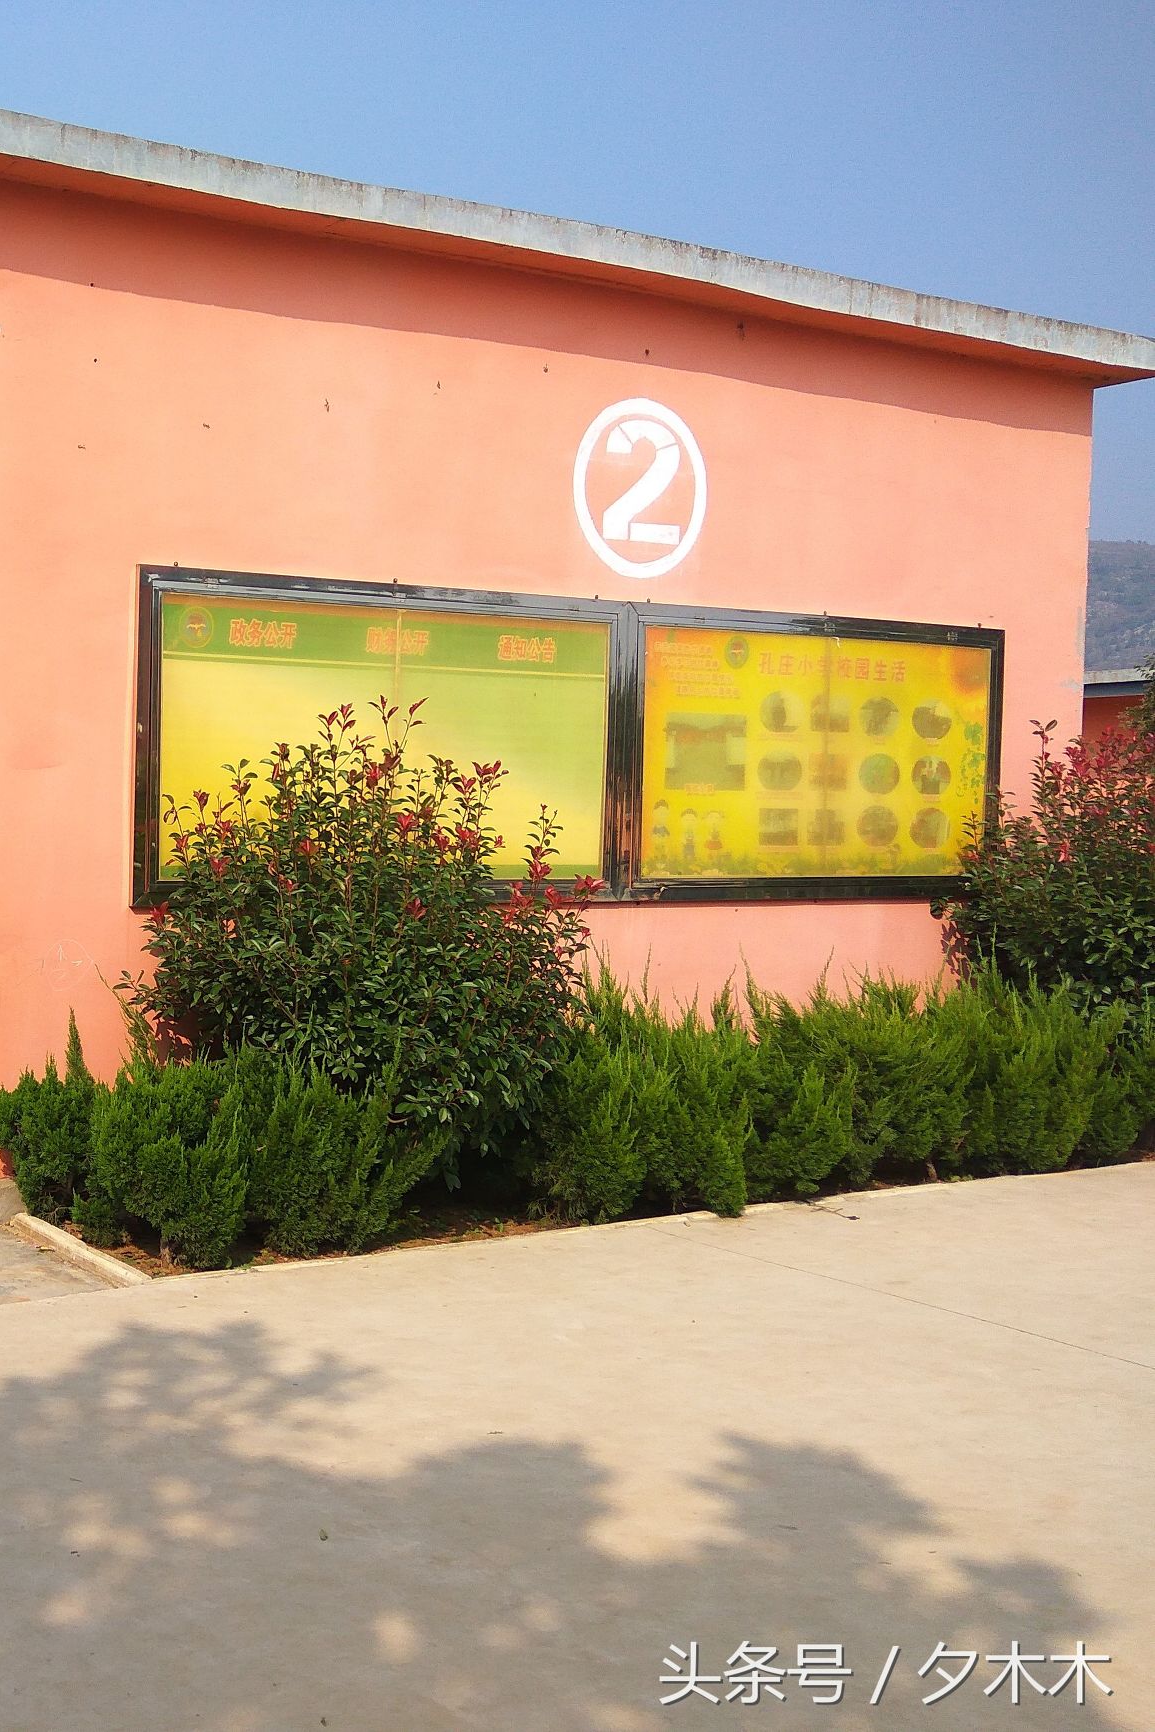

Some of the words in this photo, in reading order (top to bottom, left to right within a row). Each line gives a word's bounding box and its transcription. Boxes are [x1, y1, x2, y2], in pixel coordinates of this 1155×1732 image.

[603, 419, 681, 545] 2
[229, 618, 297, 648] 政务公开
[365, 626, 430, 656] 财务公开
[497, 634, 557, 664] 通知公告
